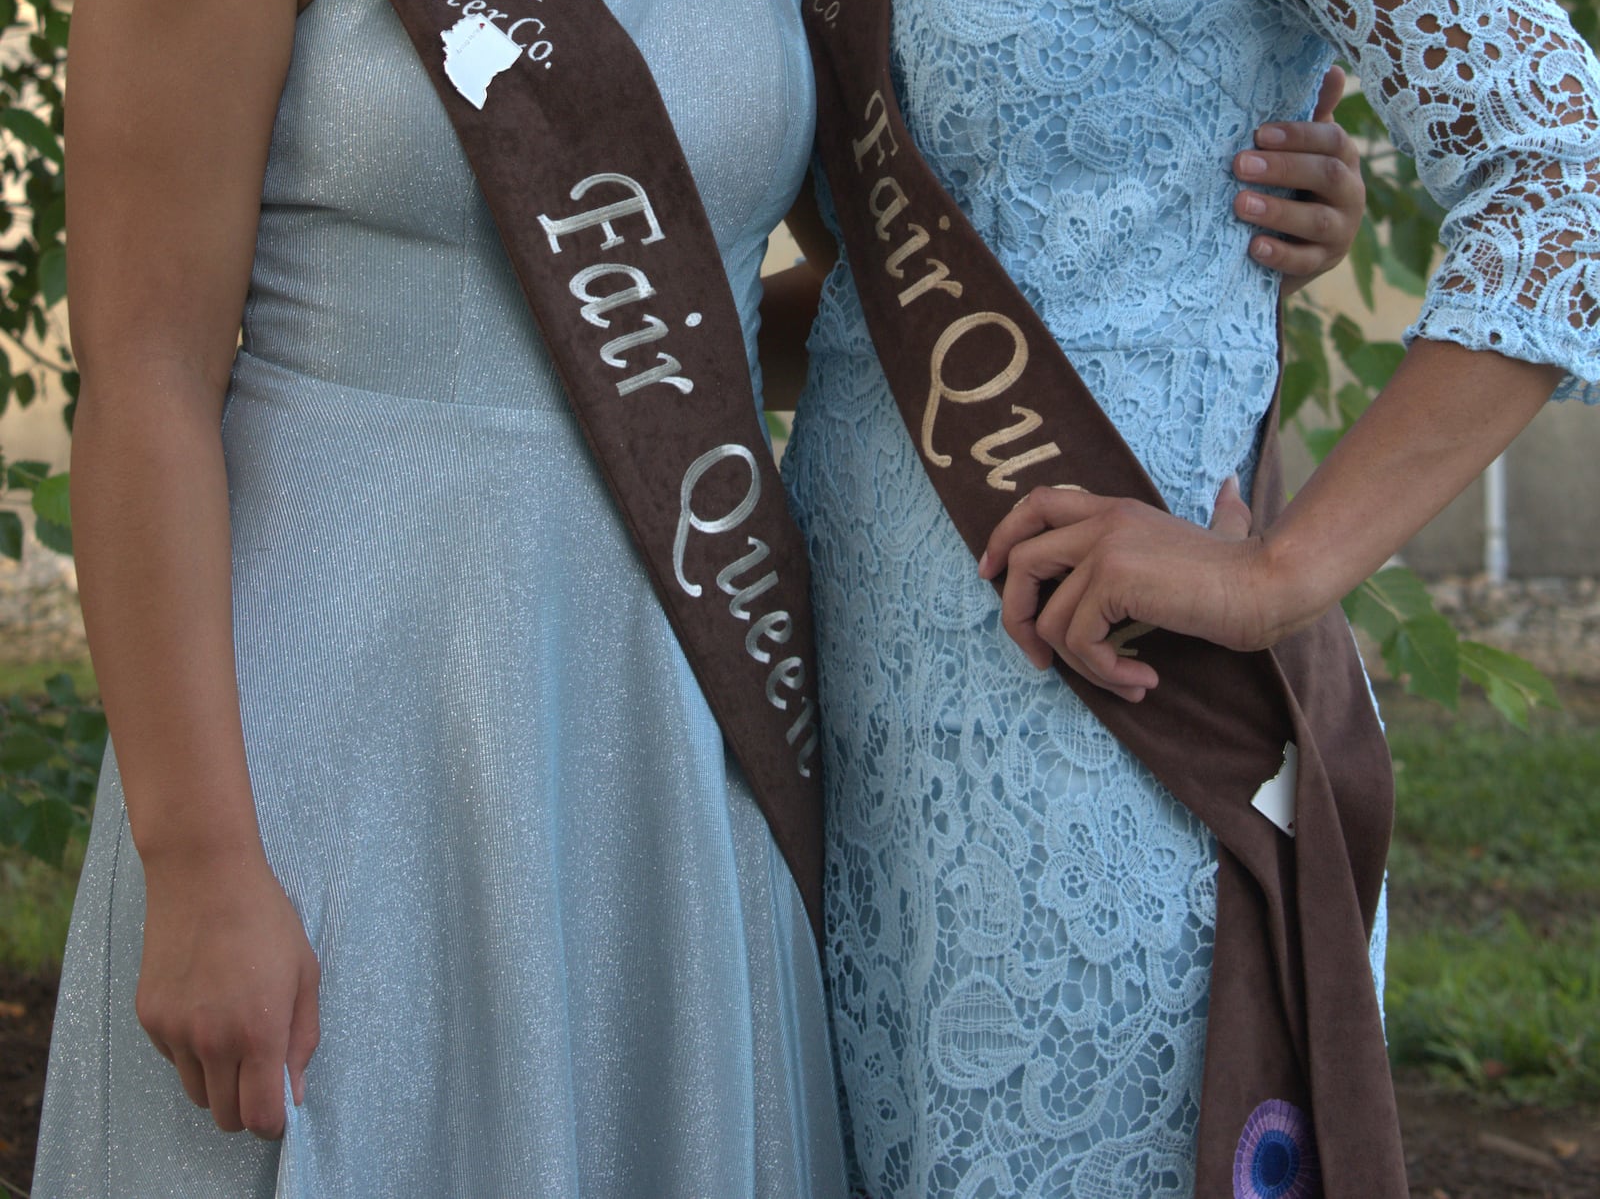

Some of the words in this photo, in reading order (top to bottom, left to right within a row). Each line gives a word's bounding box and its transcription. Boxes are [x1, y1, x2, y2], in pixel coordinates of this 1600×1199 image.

[506, 17, 553, 69] Co.
[853, 89, 963, 308] Fair
[536, 171, 702, 397] Fair
[672, 443, 819, 778] Queen
